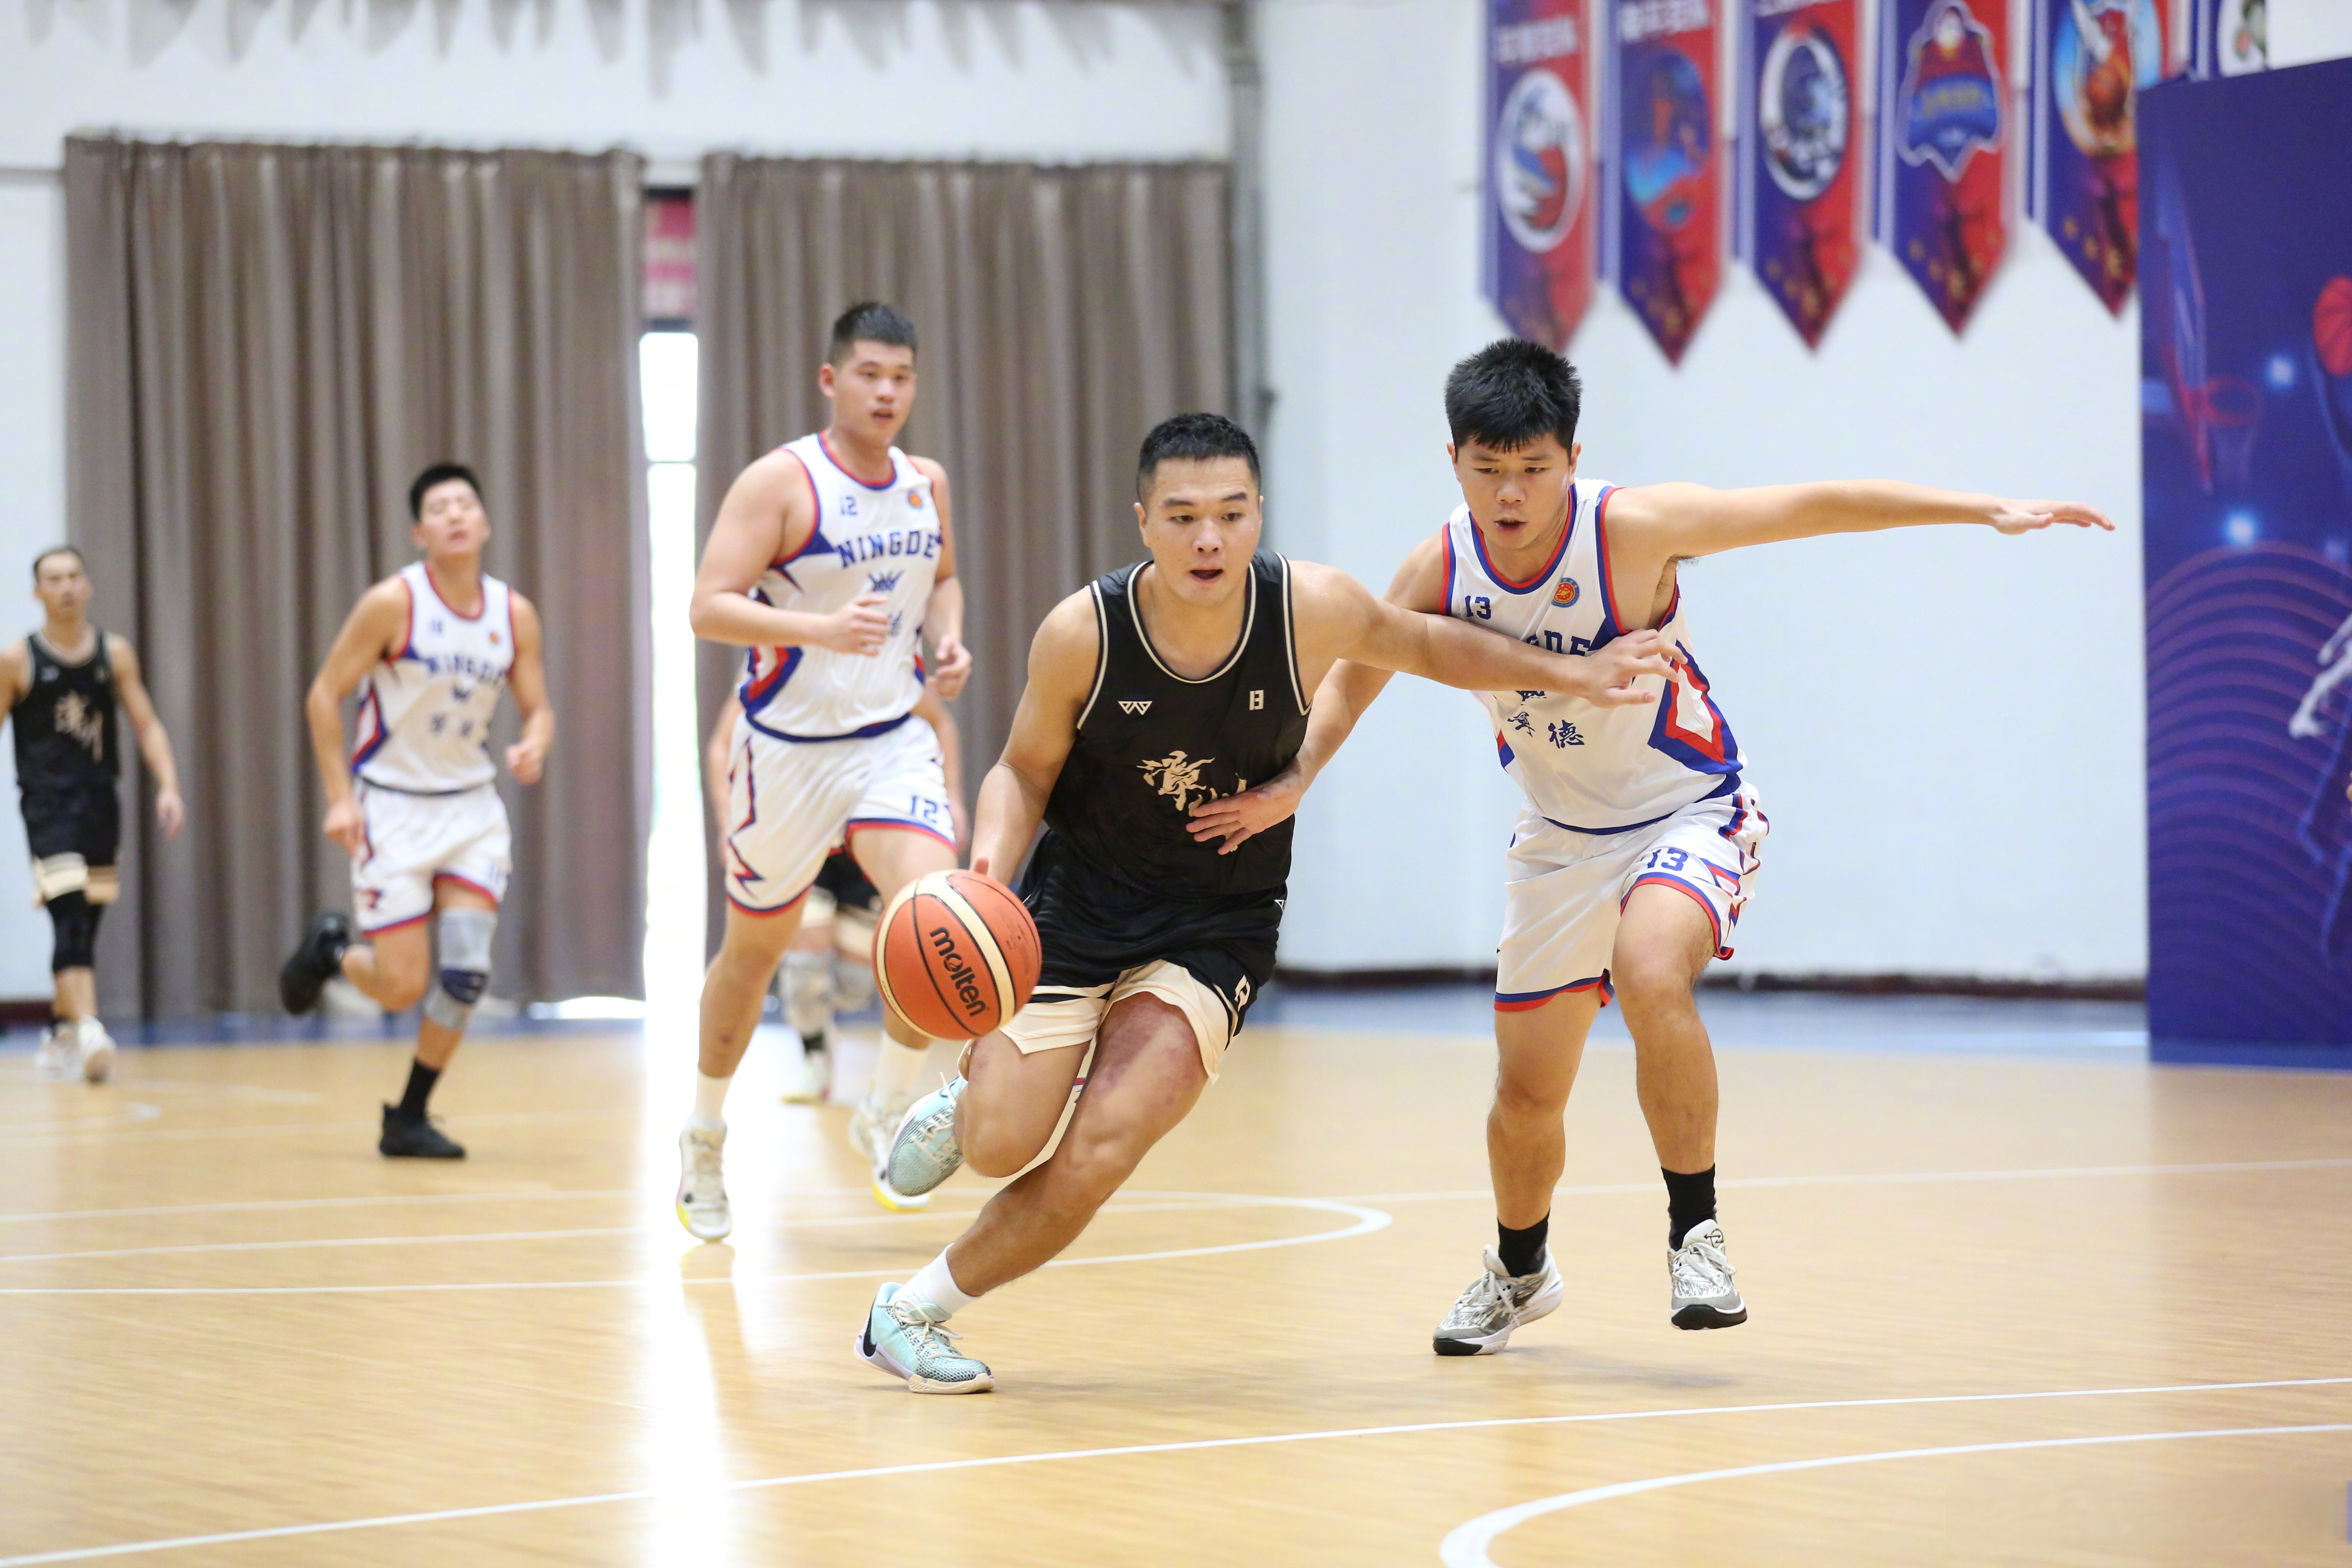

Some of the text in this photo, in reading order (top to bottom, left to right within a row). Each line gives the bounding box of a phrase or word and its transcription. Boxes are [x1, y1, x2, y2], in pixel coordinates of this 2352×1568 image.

[840, 496, 857, 515] 12
[837, 531, 935, 568] NINGDE
[1465, 595, 1491, 619] 13
[911, 795, 937, 823] 12
[1647, 849, 1688, 871] 13
[930, 927, 986, 1016] molten
